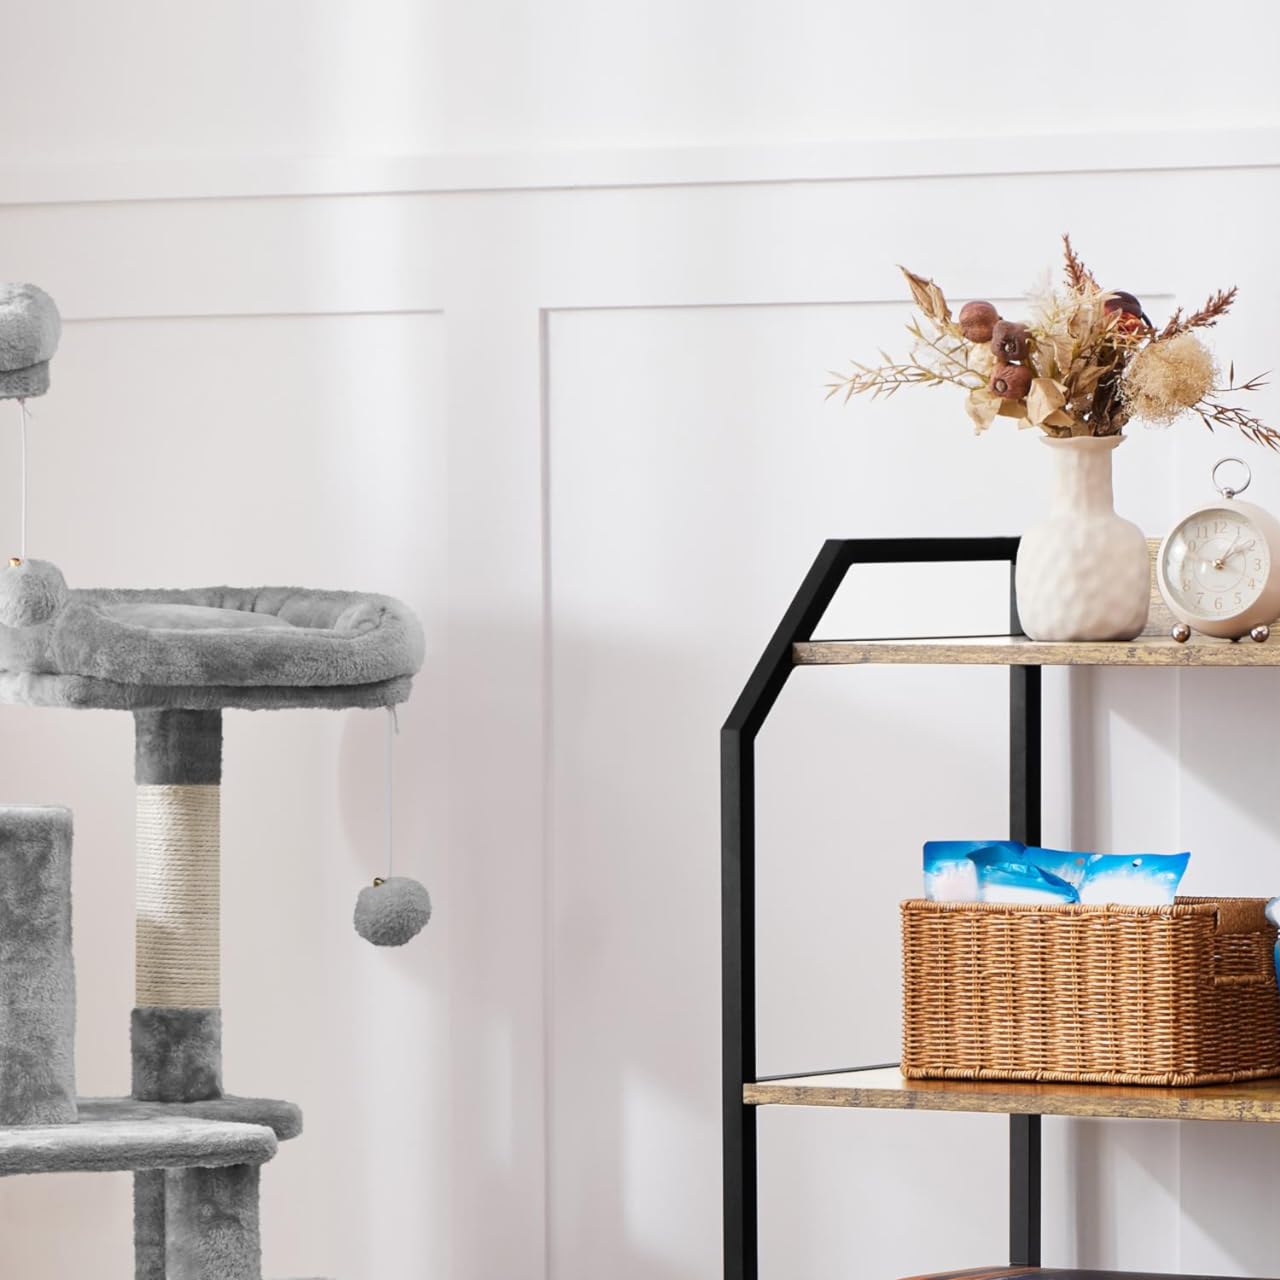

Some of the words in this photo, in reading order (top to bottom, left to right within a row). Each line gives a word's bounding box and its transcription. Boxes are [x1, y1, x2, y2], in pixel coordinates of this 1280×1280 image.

[1196, 526, 1208, 538] 11
[1214, 521, 1228, 534] 12
[1247, 540, 1256, 552] 2
[1255, 559, 1262, 571] 3
[1247, 578, 1256, 590] 4
[1196, 592, 1205, 605] 7
[1215, 598, 1223, 610] 6
[1234, 592, 1242, 605] 5
